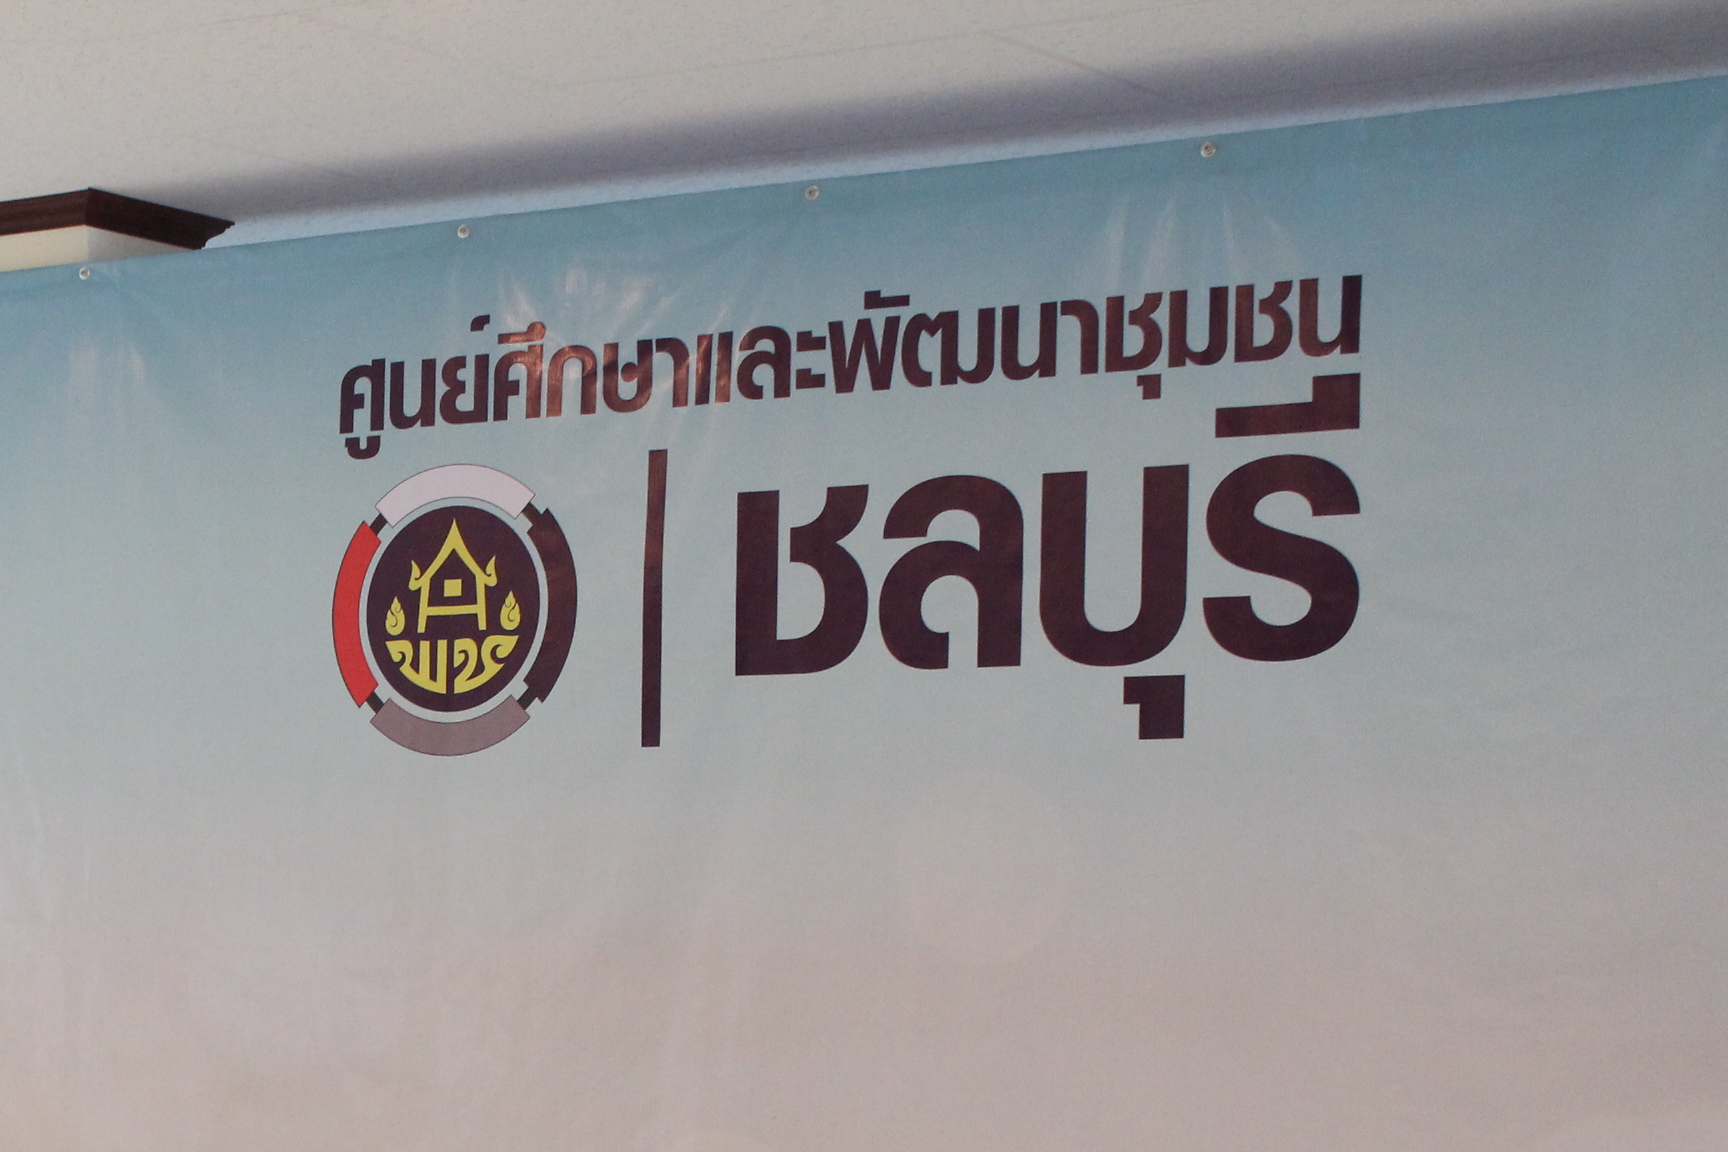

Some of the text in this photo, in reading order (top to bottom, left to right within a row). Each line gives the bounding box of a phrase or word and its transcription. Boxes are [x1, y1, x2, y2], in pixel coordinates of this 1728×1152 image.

[339, 274, 1363, 460] ศูนย์ศึกษาและพัฒนาชุมชน
[734, 372, 1362, 741] ชลบุรี
